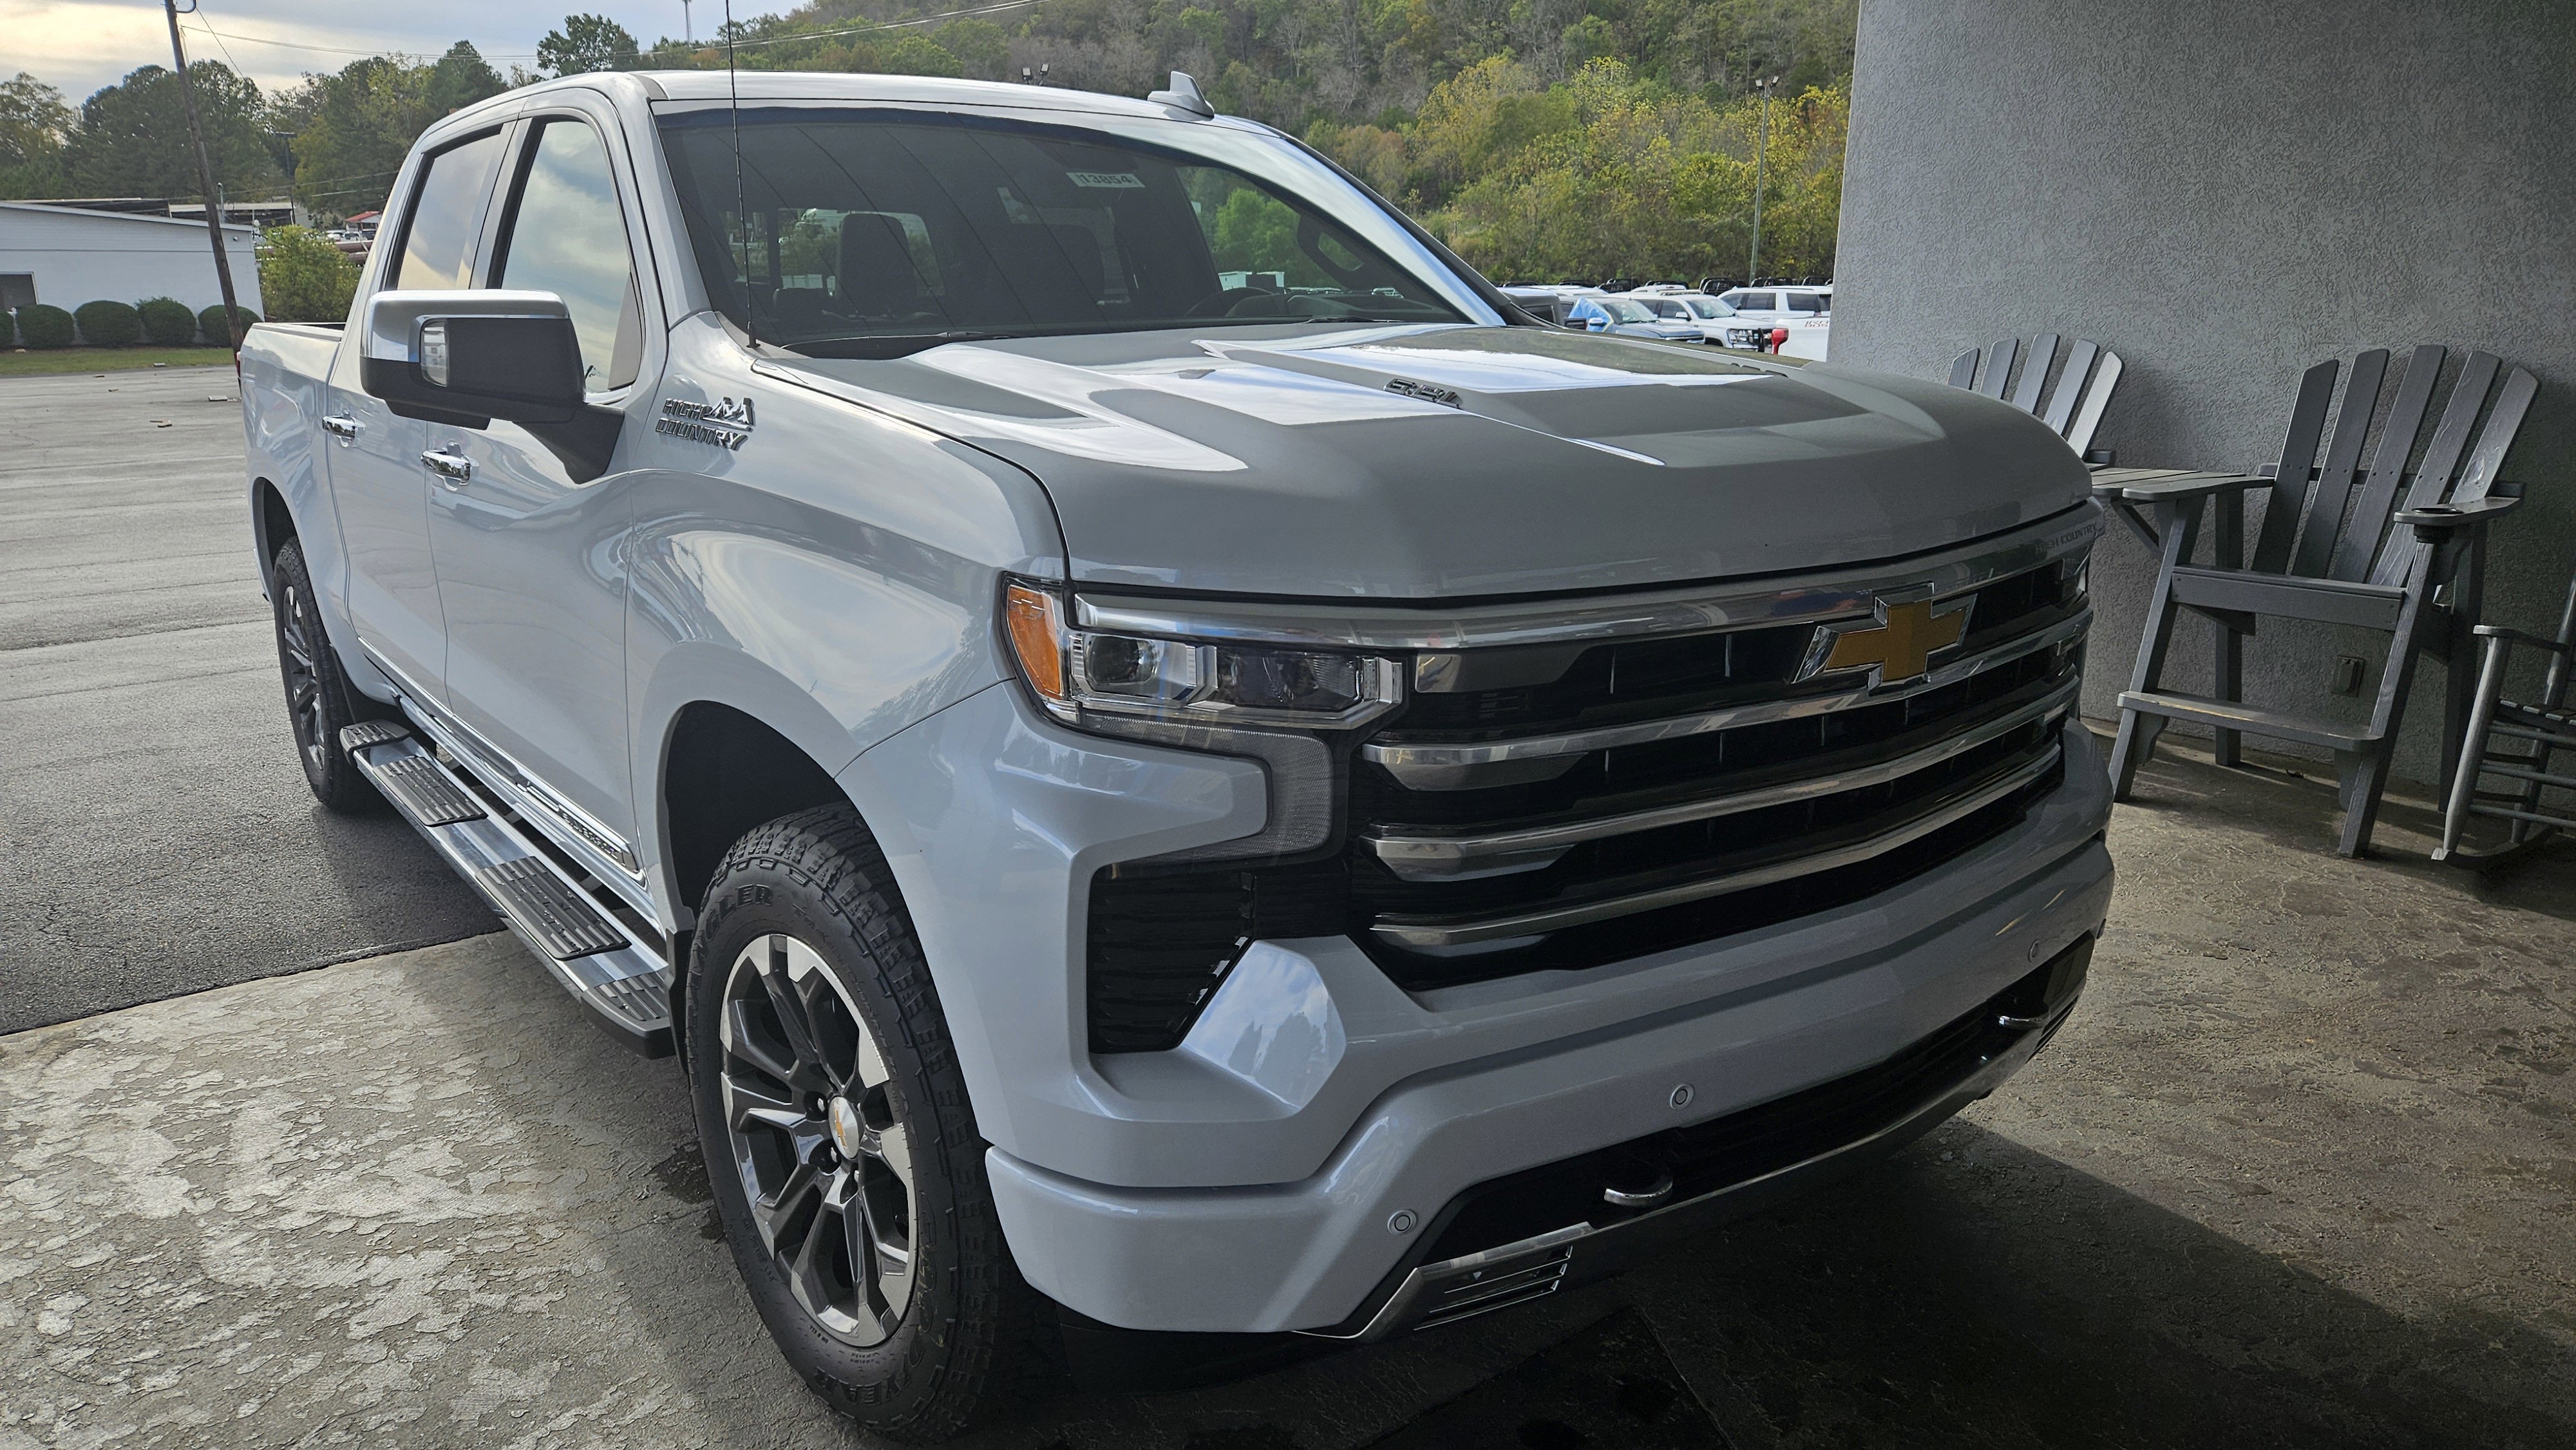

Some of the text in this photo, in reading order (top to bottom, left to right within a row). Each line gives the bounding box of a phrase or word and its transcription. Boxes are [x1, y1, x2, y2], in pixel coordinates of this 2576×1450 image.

[1077, 173, 1132, 184] 13854
[662, 397, 712, 421] HIGH
[656, 417, 748, 451] COUNTRY
[2035, 522, 2098, 555] HIGH COUNTRY
